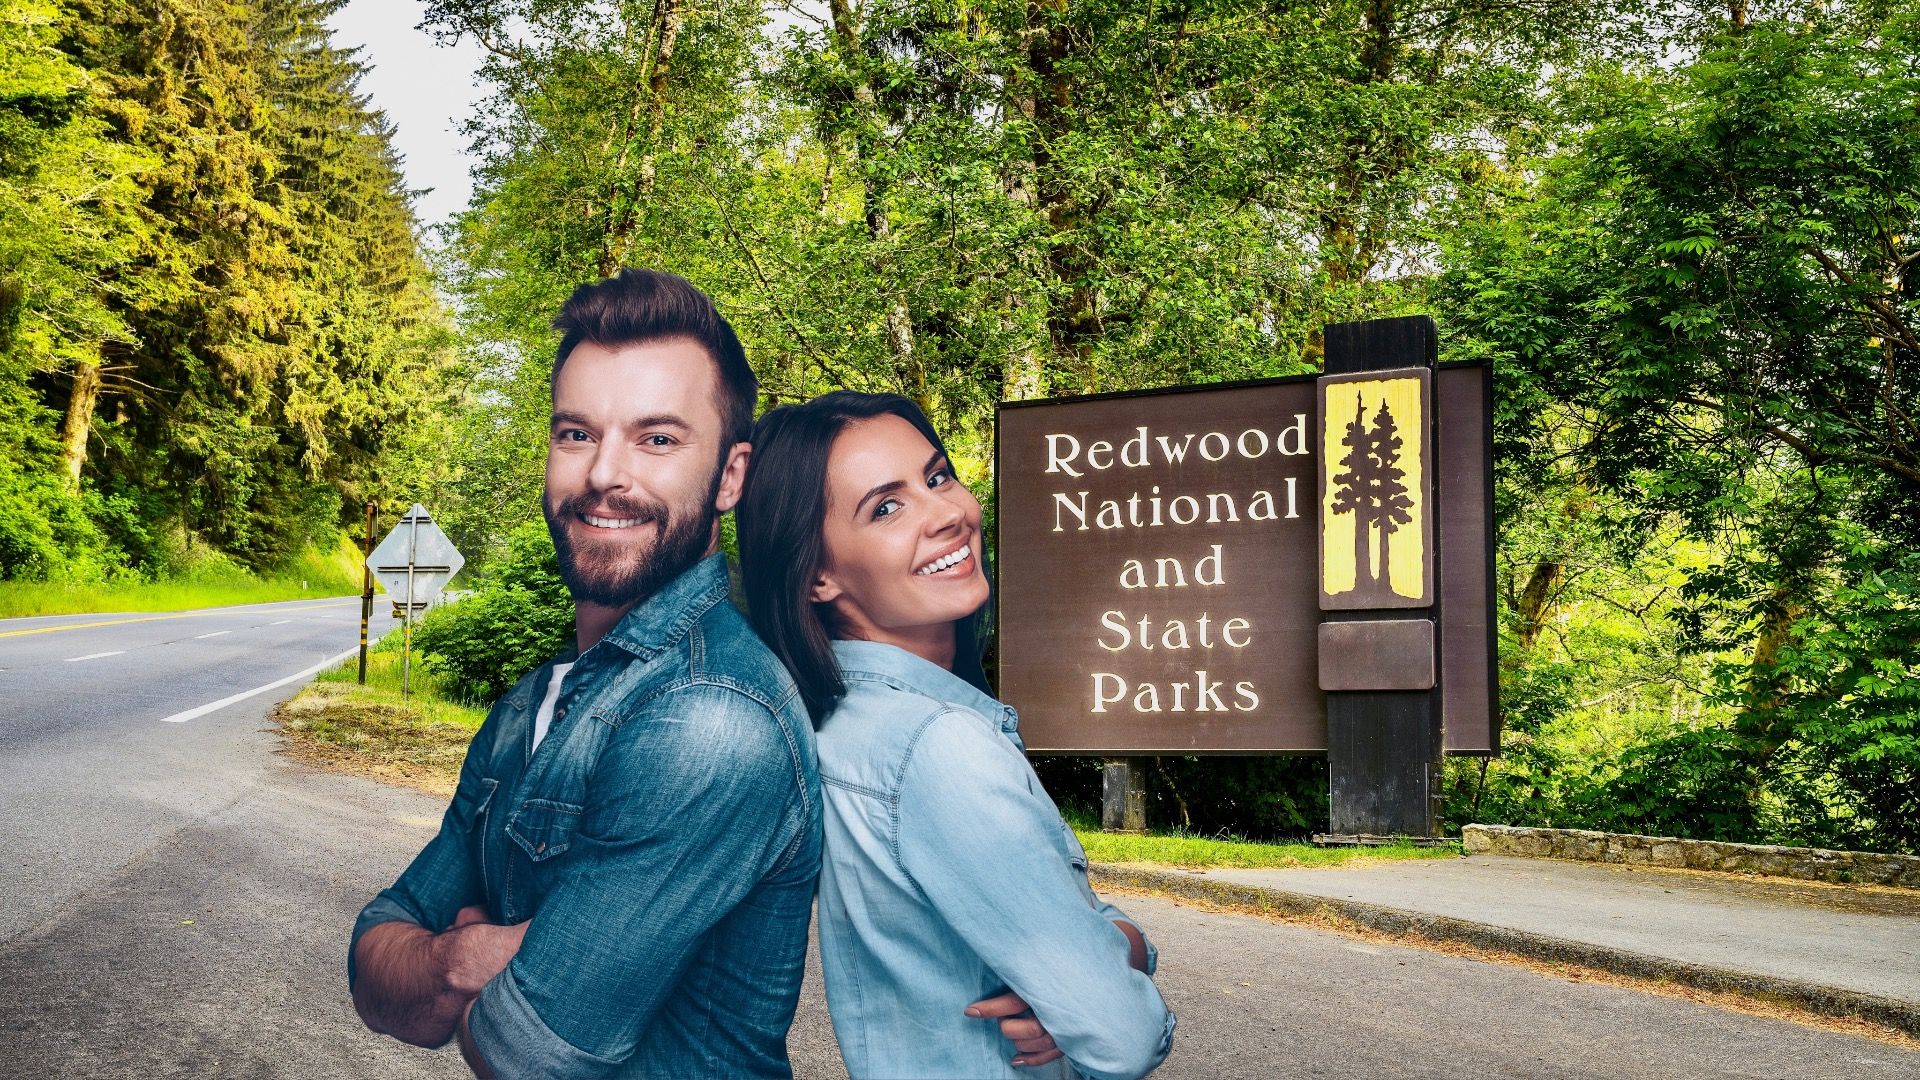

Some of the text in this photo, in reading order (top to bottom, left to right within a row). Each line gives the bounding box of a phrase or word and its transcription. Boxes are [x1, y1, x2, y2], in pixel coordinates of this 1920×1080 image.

[1044, 413, 1309, 478] Redwood
[1052, 477, 1300, 532] National
[1119, 544, 1226, 589] and
[1097, 610, 1252, 652] State
[1090, 670, 1260, 713] Parks
